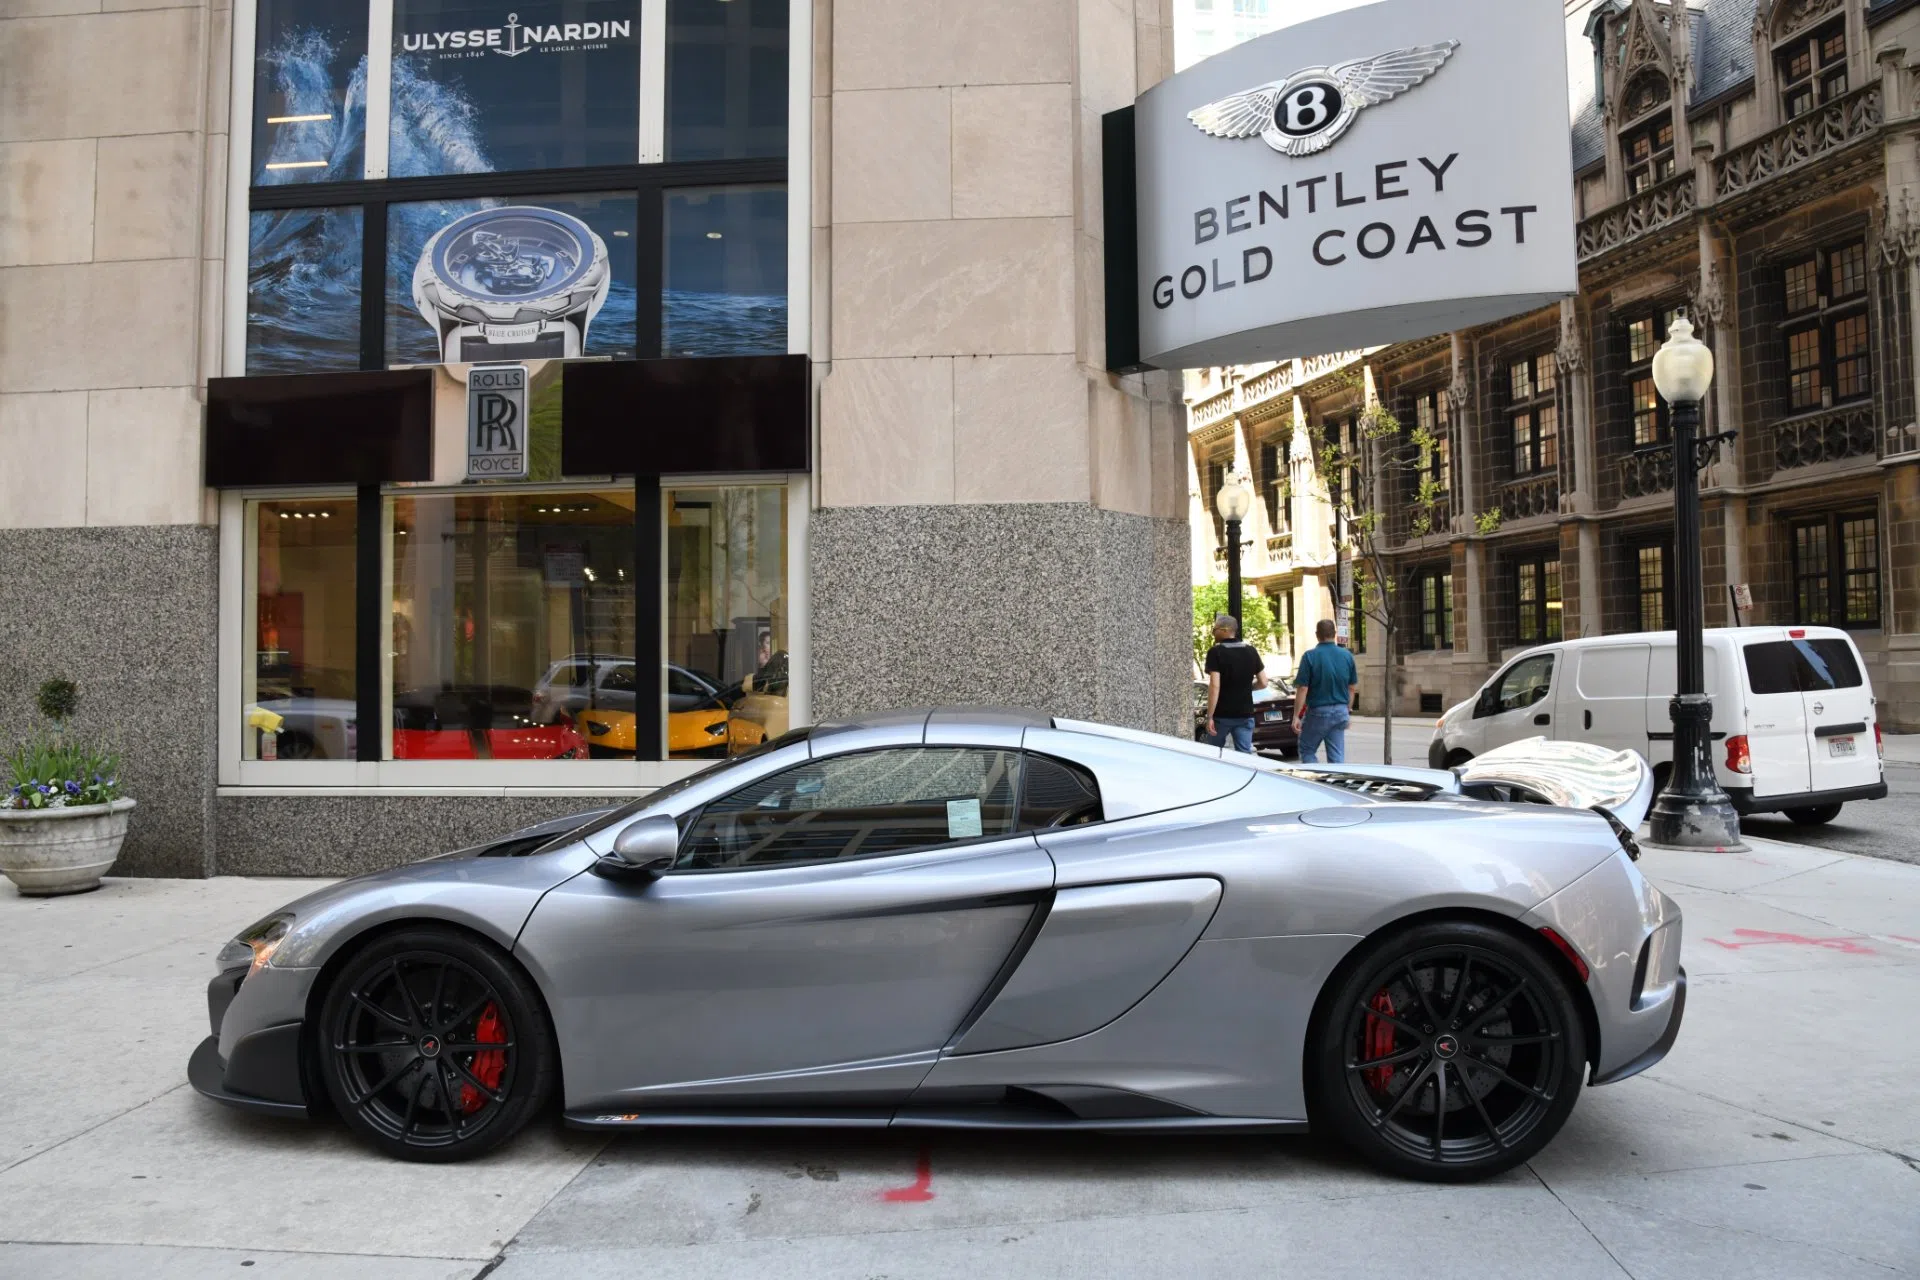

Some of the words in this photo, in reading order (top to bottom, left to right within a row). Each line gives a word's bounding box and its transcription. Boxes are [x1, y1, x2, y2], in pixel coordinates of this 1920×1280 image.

[403, 28, 502, 51] ULYSSE
[523, 20, 631, 44] NARDIN
[1285, 86, 1328, 131] B
[1194, 153, 1459, 245] BENTLEY
[1153, 246, 1273, 309] GOLD
[1312, 205, 1537, 266] COAST
[473, 373, 520, 387] ROLLS
[472, 457, 519, 471] ROYCE
